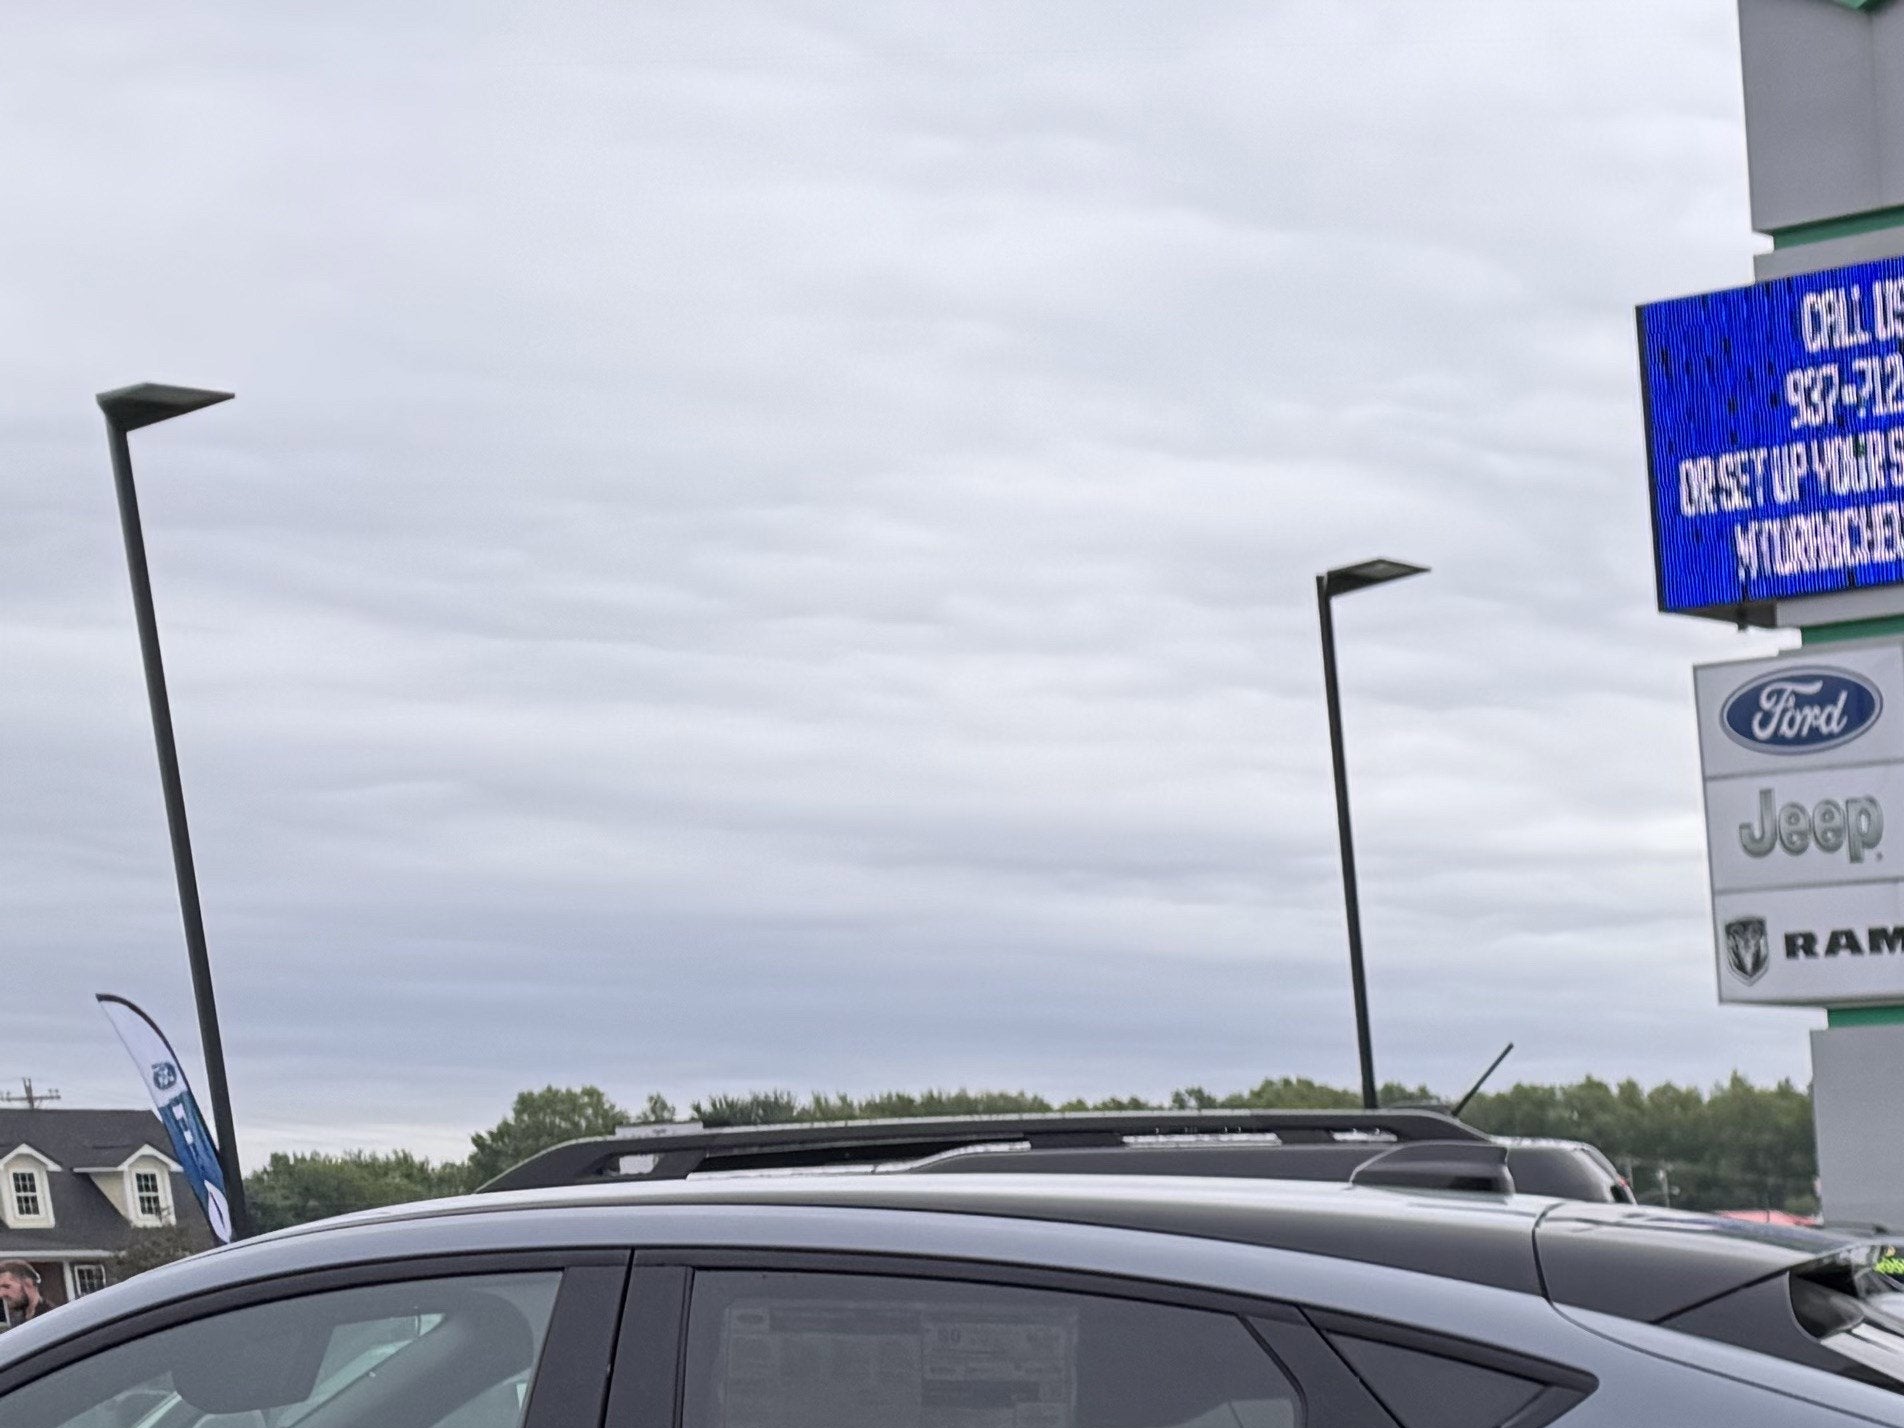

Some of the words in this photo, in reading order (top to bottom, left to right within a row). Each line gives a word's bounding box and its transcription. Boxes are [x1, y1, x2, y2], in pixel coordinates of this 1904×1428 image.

[1802, 283, 1871, 353] CALL
[1680, 456, 1717, 519] OR
[1719, 447, 1768, 512] SET
[1770, 441, 1808, 505] UP
[1811, 430, 1886, 496] YOUR
[1752, 682, 1849, 739] Ford
[1738, 788, 1885, 863] Jeep
